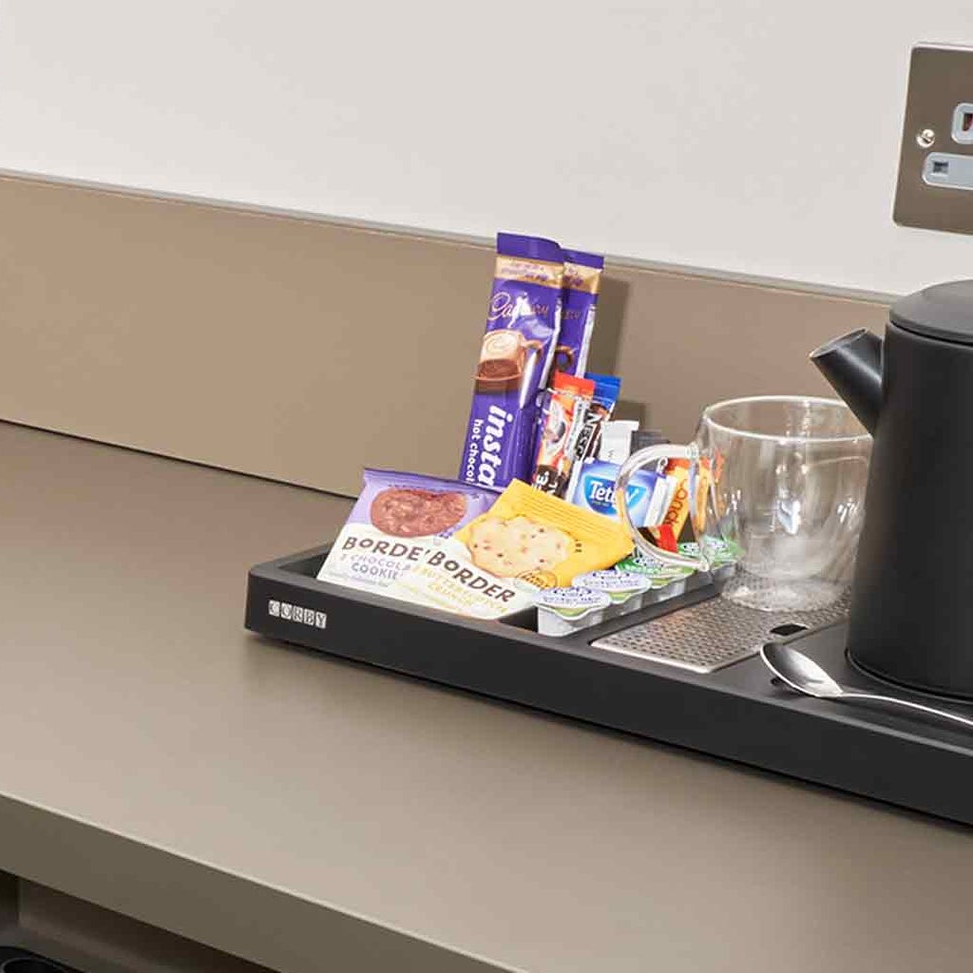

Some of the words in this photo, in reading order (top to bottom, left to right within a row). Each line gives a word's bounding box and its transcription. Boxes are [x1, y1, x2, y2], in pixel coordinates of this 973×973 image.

[471, 419, 483, 442] hot
[342, 536, 431, 561] BORDE
[427, 551, 515, 602] BORDER
[268, 600, 327, 629] CORBY
